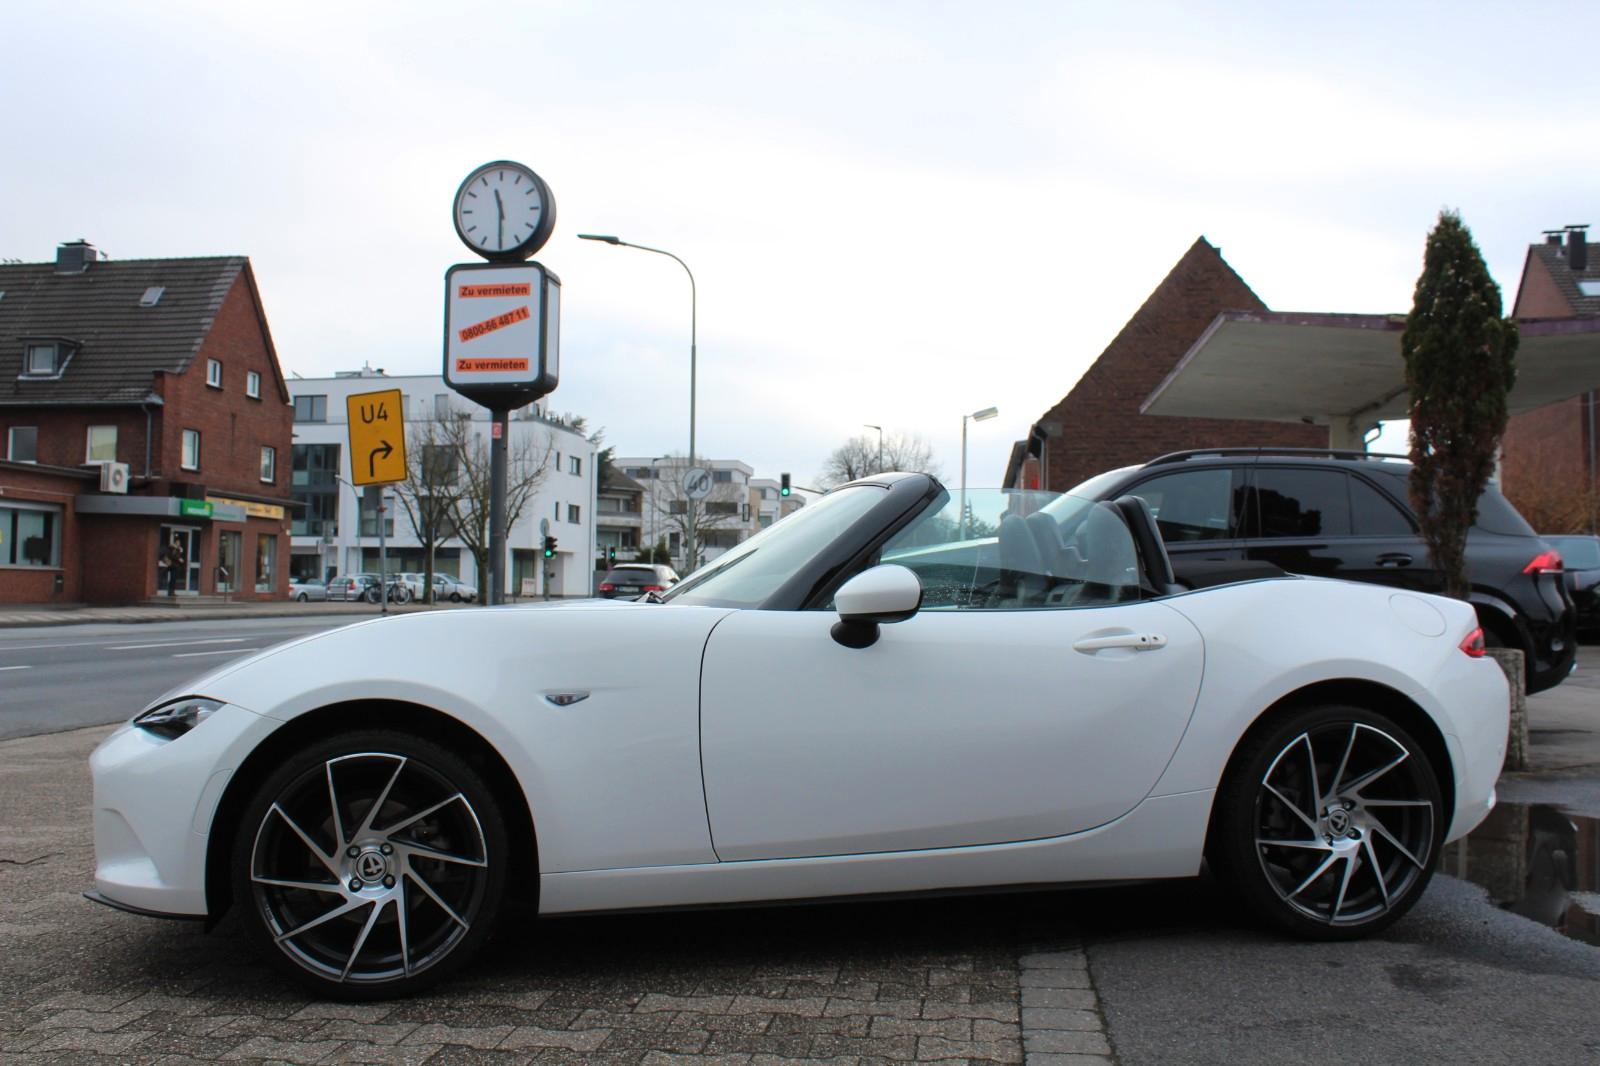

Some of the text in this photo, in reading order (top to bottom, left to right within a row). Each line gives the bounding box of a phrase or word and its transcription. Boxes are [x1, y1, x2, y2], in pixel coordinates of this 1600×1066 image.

[462, 286, 527, 296] Zu vermieten
[462, 308, 527, 340] 0800-66 487 11
[459, 360, 525, 370] Zu vermieten
[361, 402, 388, 424] U4
[688, 474, 708, 491] 40
